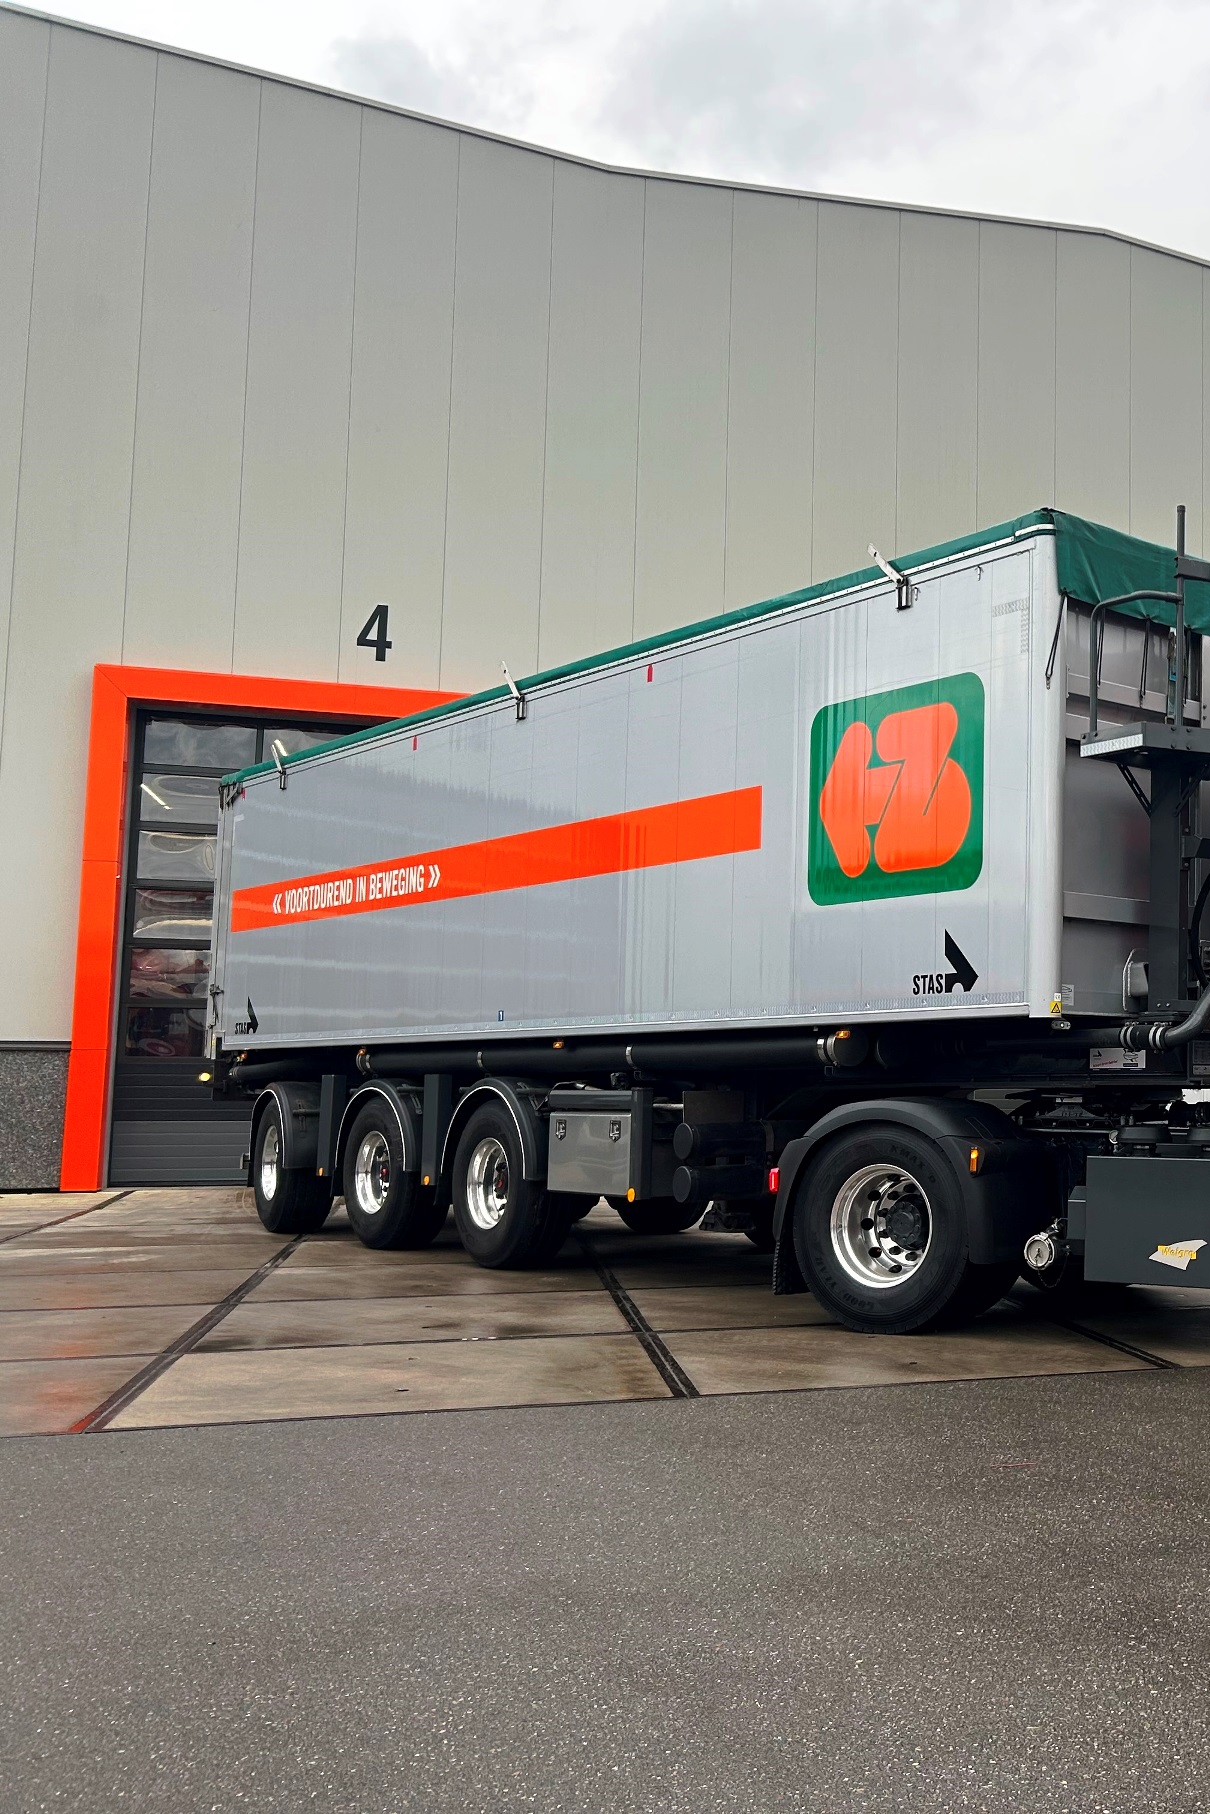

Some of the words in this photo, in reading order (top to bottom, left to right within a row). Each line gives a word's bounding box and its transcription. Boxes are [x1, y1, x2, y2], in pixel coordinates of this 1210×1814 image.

[356, 604, 393, 662] 4
[285, 878, 353, 915] VOORTDUREND
[355, 875, 367, 903] IN
[368, 864, 425, 900] BEWEGING
[912, 973, 944, 995] STAS
